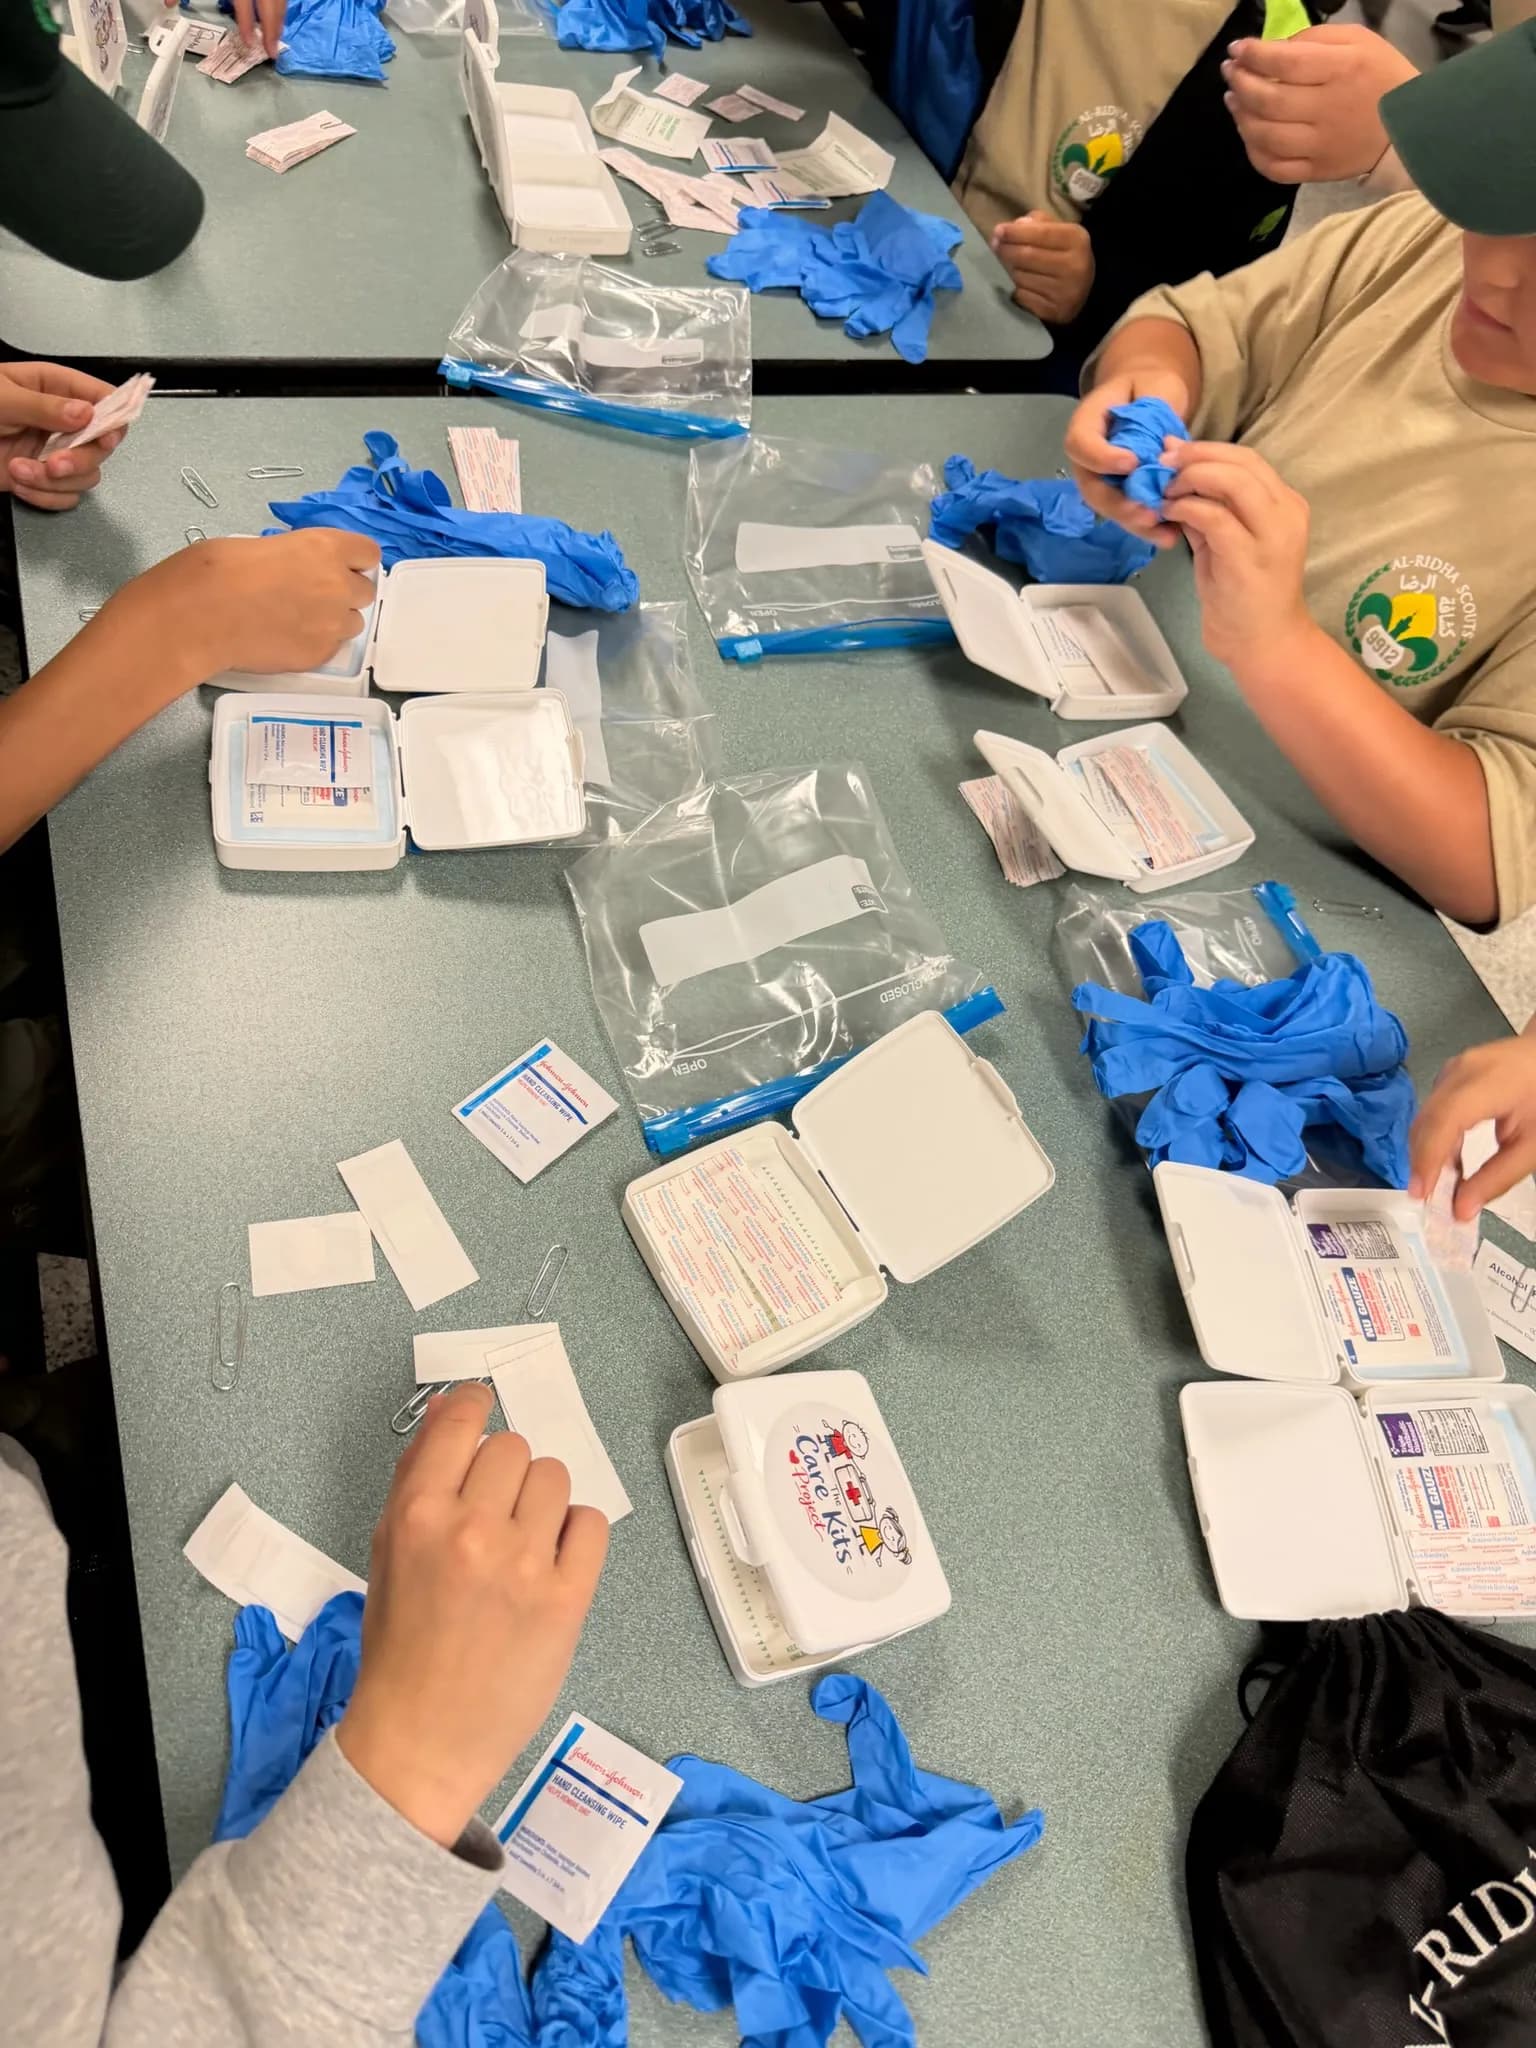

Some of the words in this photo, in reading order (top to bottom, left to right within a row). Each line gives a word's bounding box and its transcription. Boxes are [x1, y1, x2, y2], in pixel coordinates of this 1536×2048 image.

[1391, 554, 1461, 584] AL-RIDHA
[1456, 584, 1478, 640] SCOUTS
[1399, 574, 1438, 594] الرضا
[1365, 629, 1400, 665] 9912
[880, 979, 924, 1004] CLOSED
[672, 1058, 708, 1077] OPEN
[1489, 1262, 1528, 1292] Alcohol
[1346, 1277, 1368, 1315] GAUZE
[1361, 1319, 1376, 1338] NU
[795, 1434, 830, 1501] Care
[821, 1511, 853, 1564] Kits
[1421, 1467, 1441, 1506] GAUZ
[791, 1467, 826, 1543] Project
[1433, 1510, 1447, 1529] NU
[552, 1774, 572, 1792] HAND
[570, 1786, 608, 1816] CLEANSING
[606, 1810, 627, 1829] WIPE
